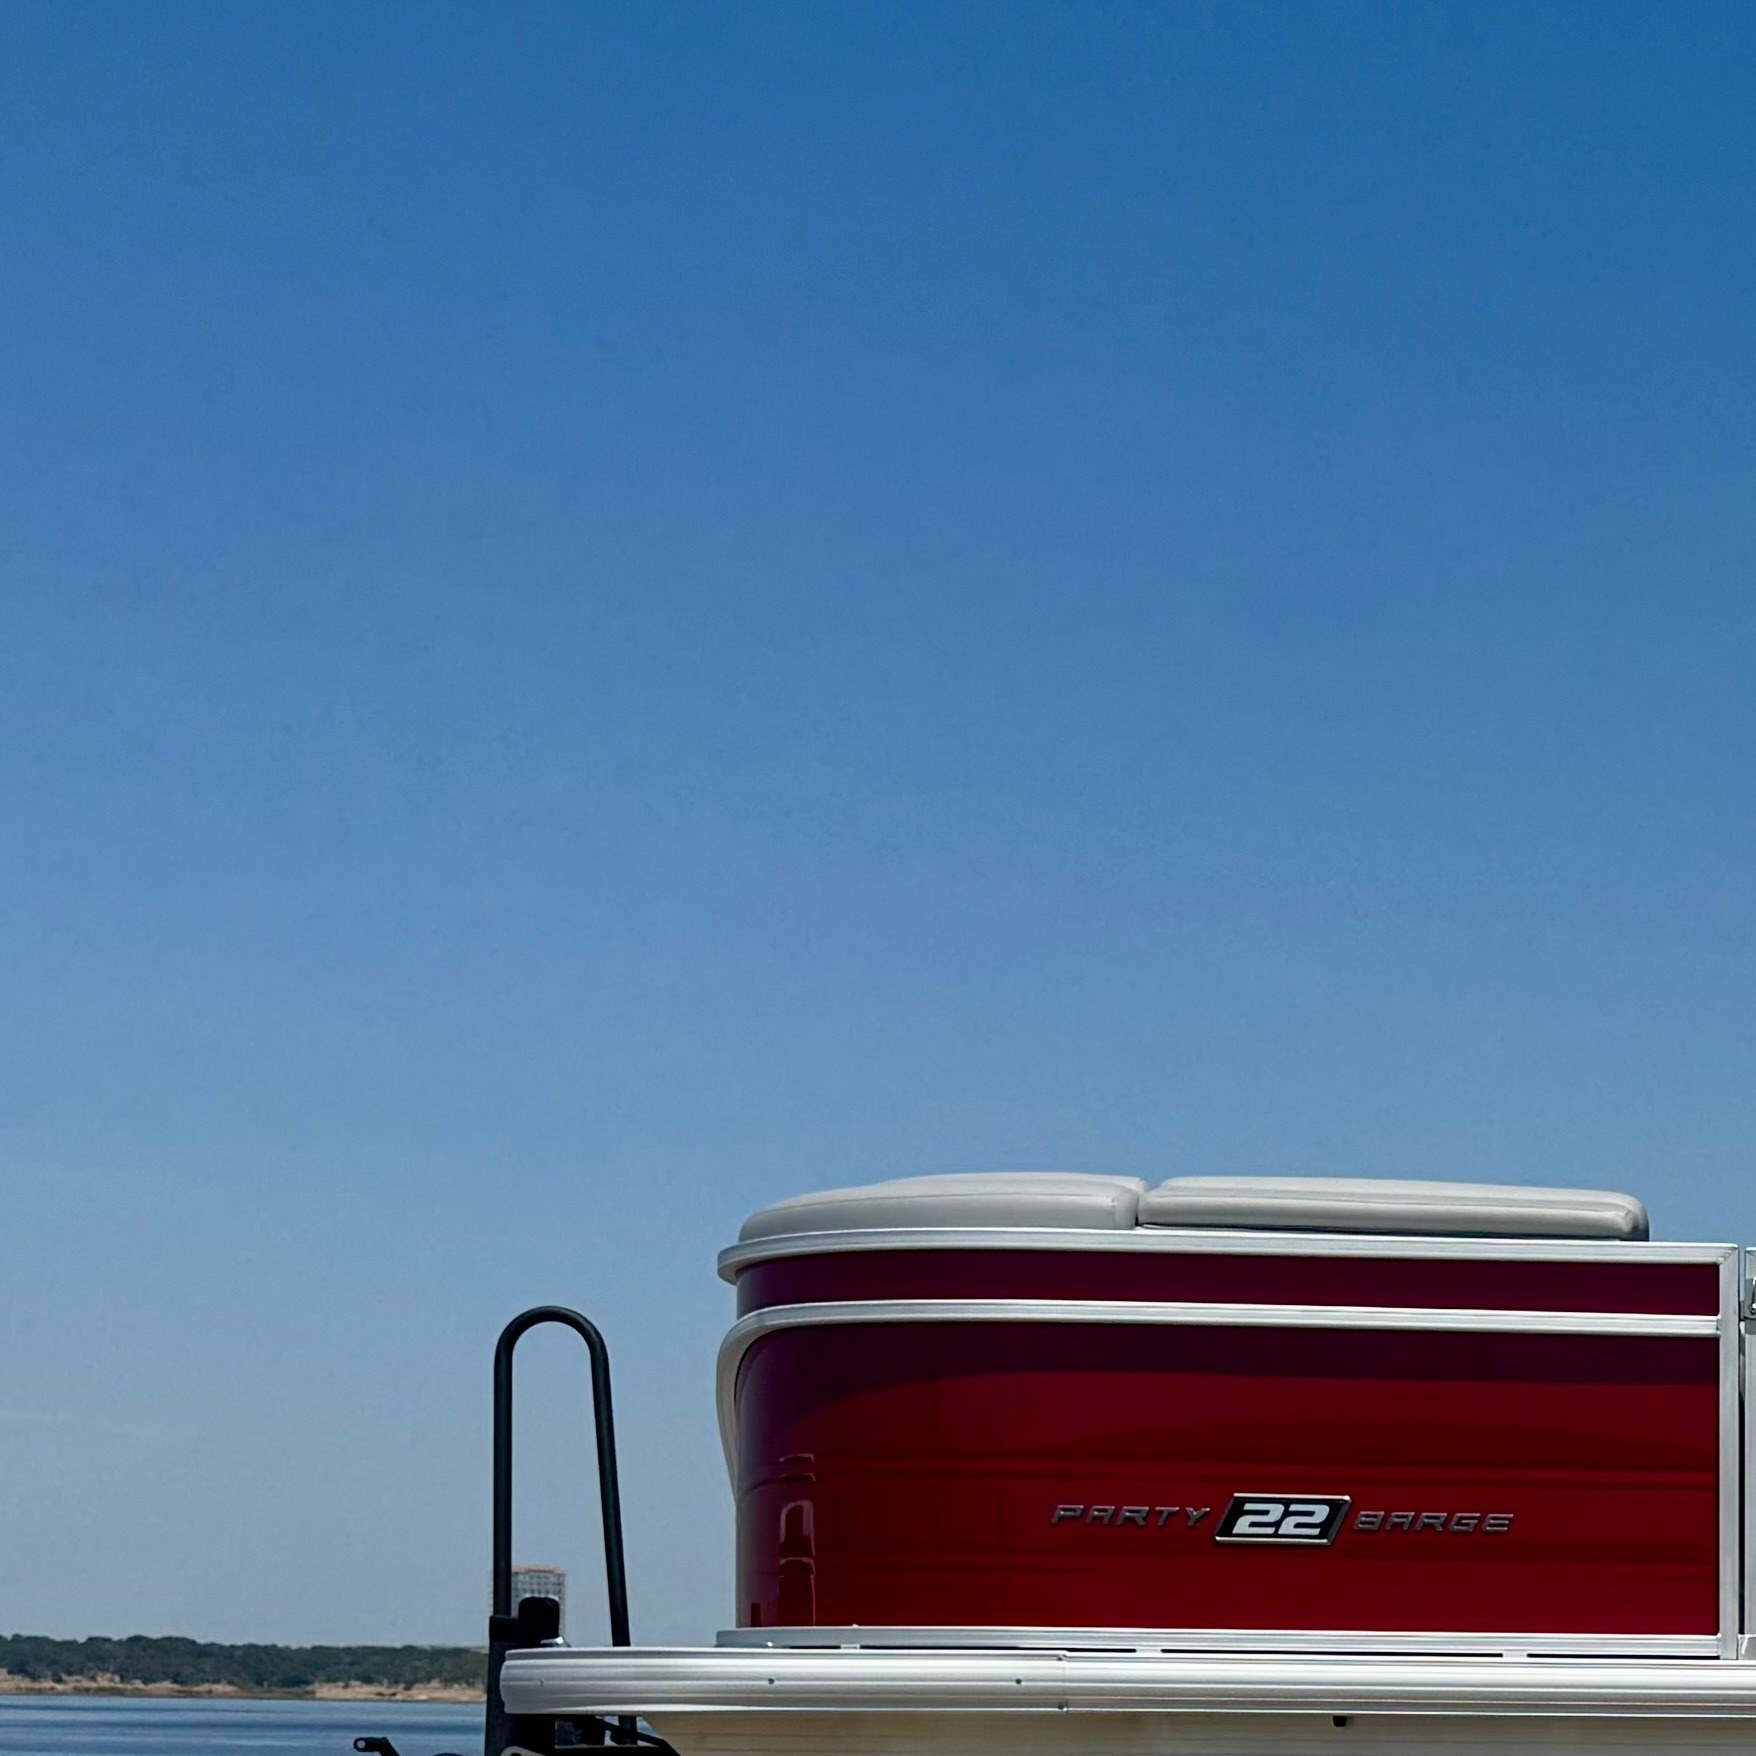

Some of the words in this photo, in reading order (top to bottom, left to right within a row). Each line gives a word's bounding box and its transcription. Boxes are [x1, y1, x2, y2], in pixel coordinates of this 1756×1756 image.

[1050, 1504, 1210, 1526] PARTY
[1232, 1503, 1330, 1535] 22
[1353, 1510, 1514, 1532] BARGE
